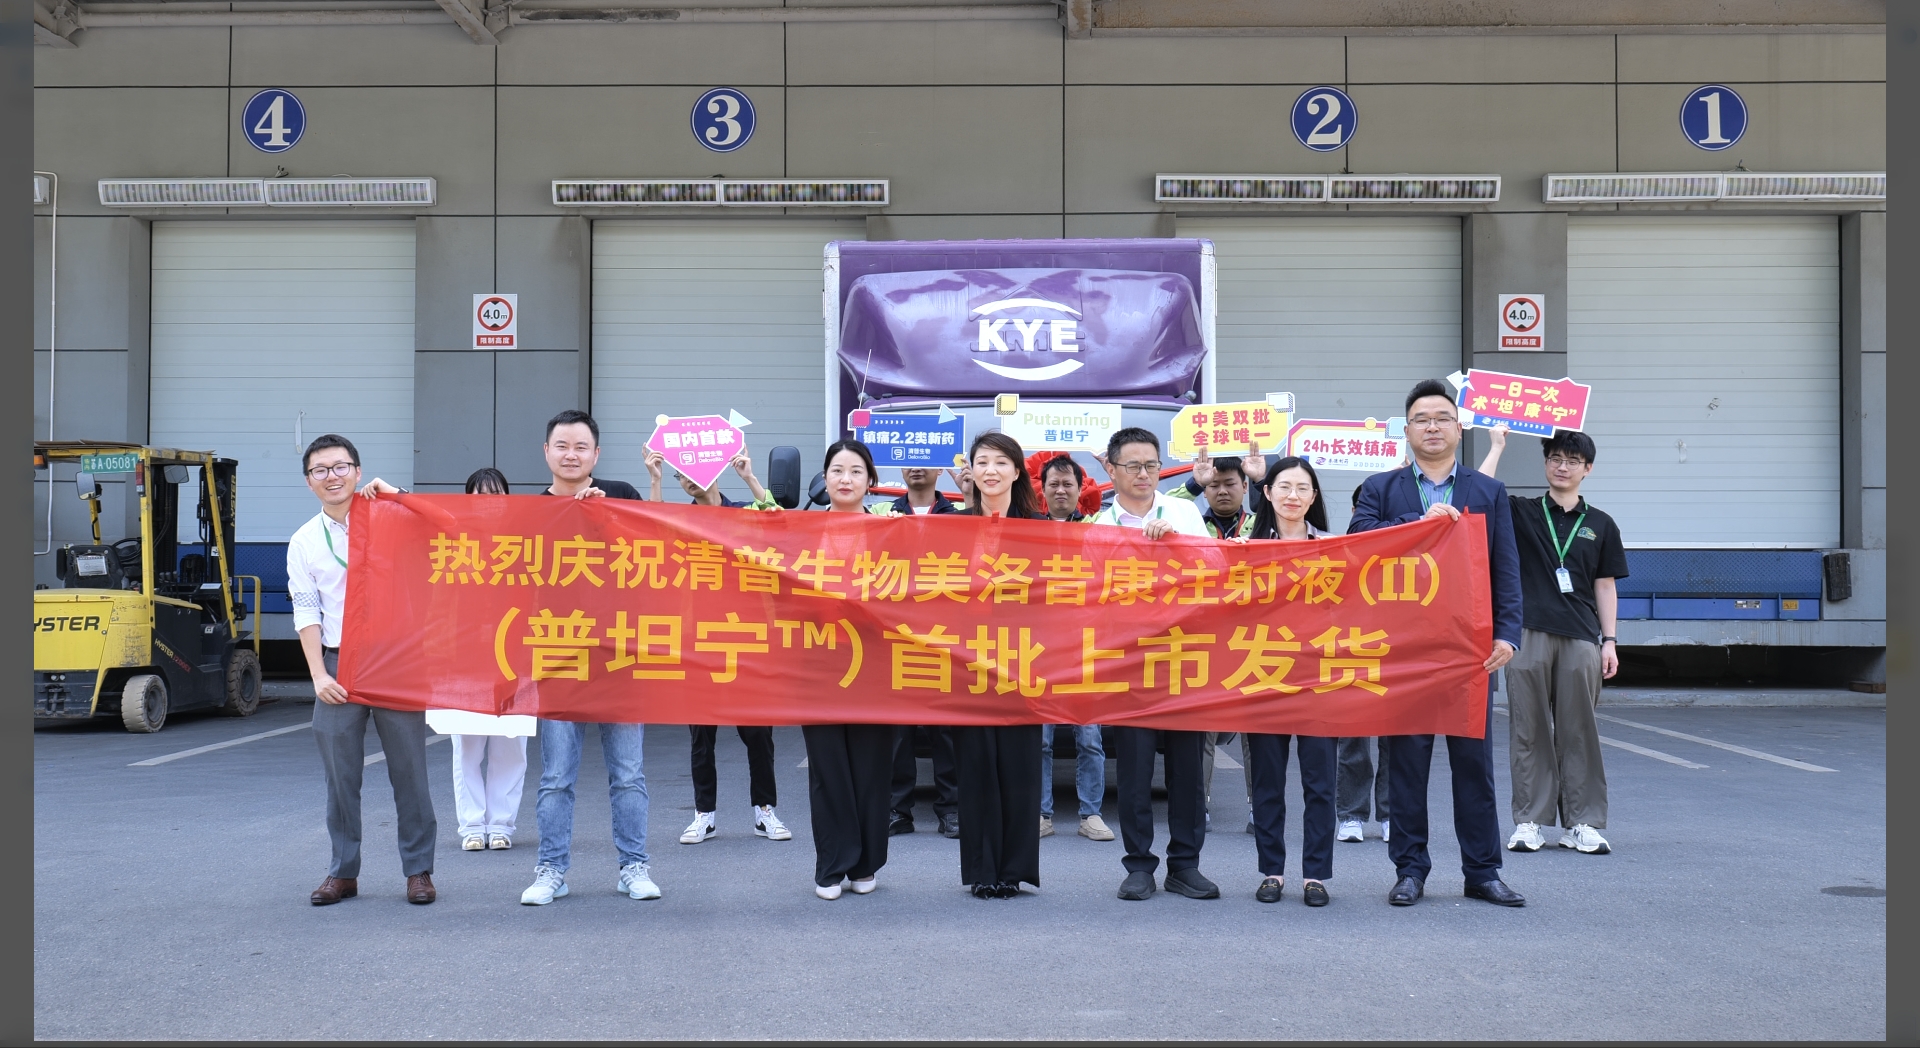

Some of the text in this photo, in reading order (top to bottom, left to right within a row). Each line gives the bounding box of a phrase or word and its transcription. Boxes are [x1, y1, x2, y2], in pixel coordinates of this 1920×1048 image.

[254, 95, 291, 146] 4
[705, 94, 742, 146] 3
[1306, 93, 1342, 145] 2
[1698, 92, 1731, 144] 1
[483, 309, 508, 320] 4.0m
[1508, 309, 1535, 320] 4.0m
[480, 337, 510, 345] 限制高度
[978, 318, 1079, 352] KYE
[1505, 338, 1537, 346] 限制高度
[1489, 381, 1560, 404] 一日一次
[1023, 412, 1110, 429] Putanning
[1191, 408, 1270, 428] 中美双批
[662, 428, 736, 449] 国内首款
[862, 430, 955, 445] 镇痛2.2类新药
[1044, 429, 1089, 442] 普坦宁
[1192, 427, 1271, 446] 全球唯一
[1303, 438, 1398, 457] 24h长效镇痛
[154, 638, 175, 659] HYSTER
